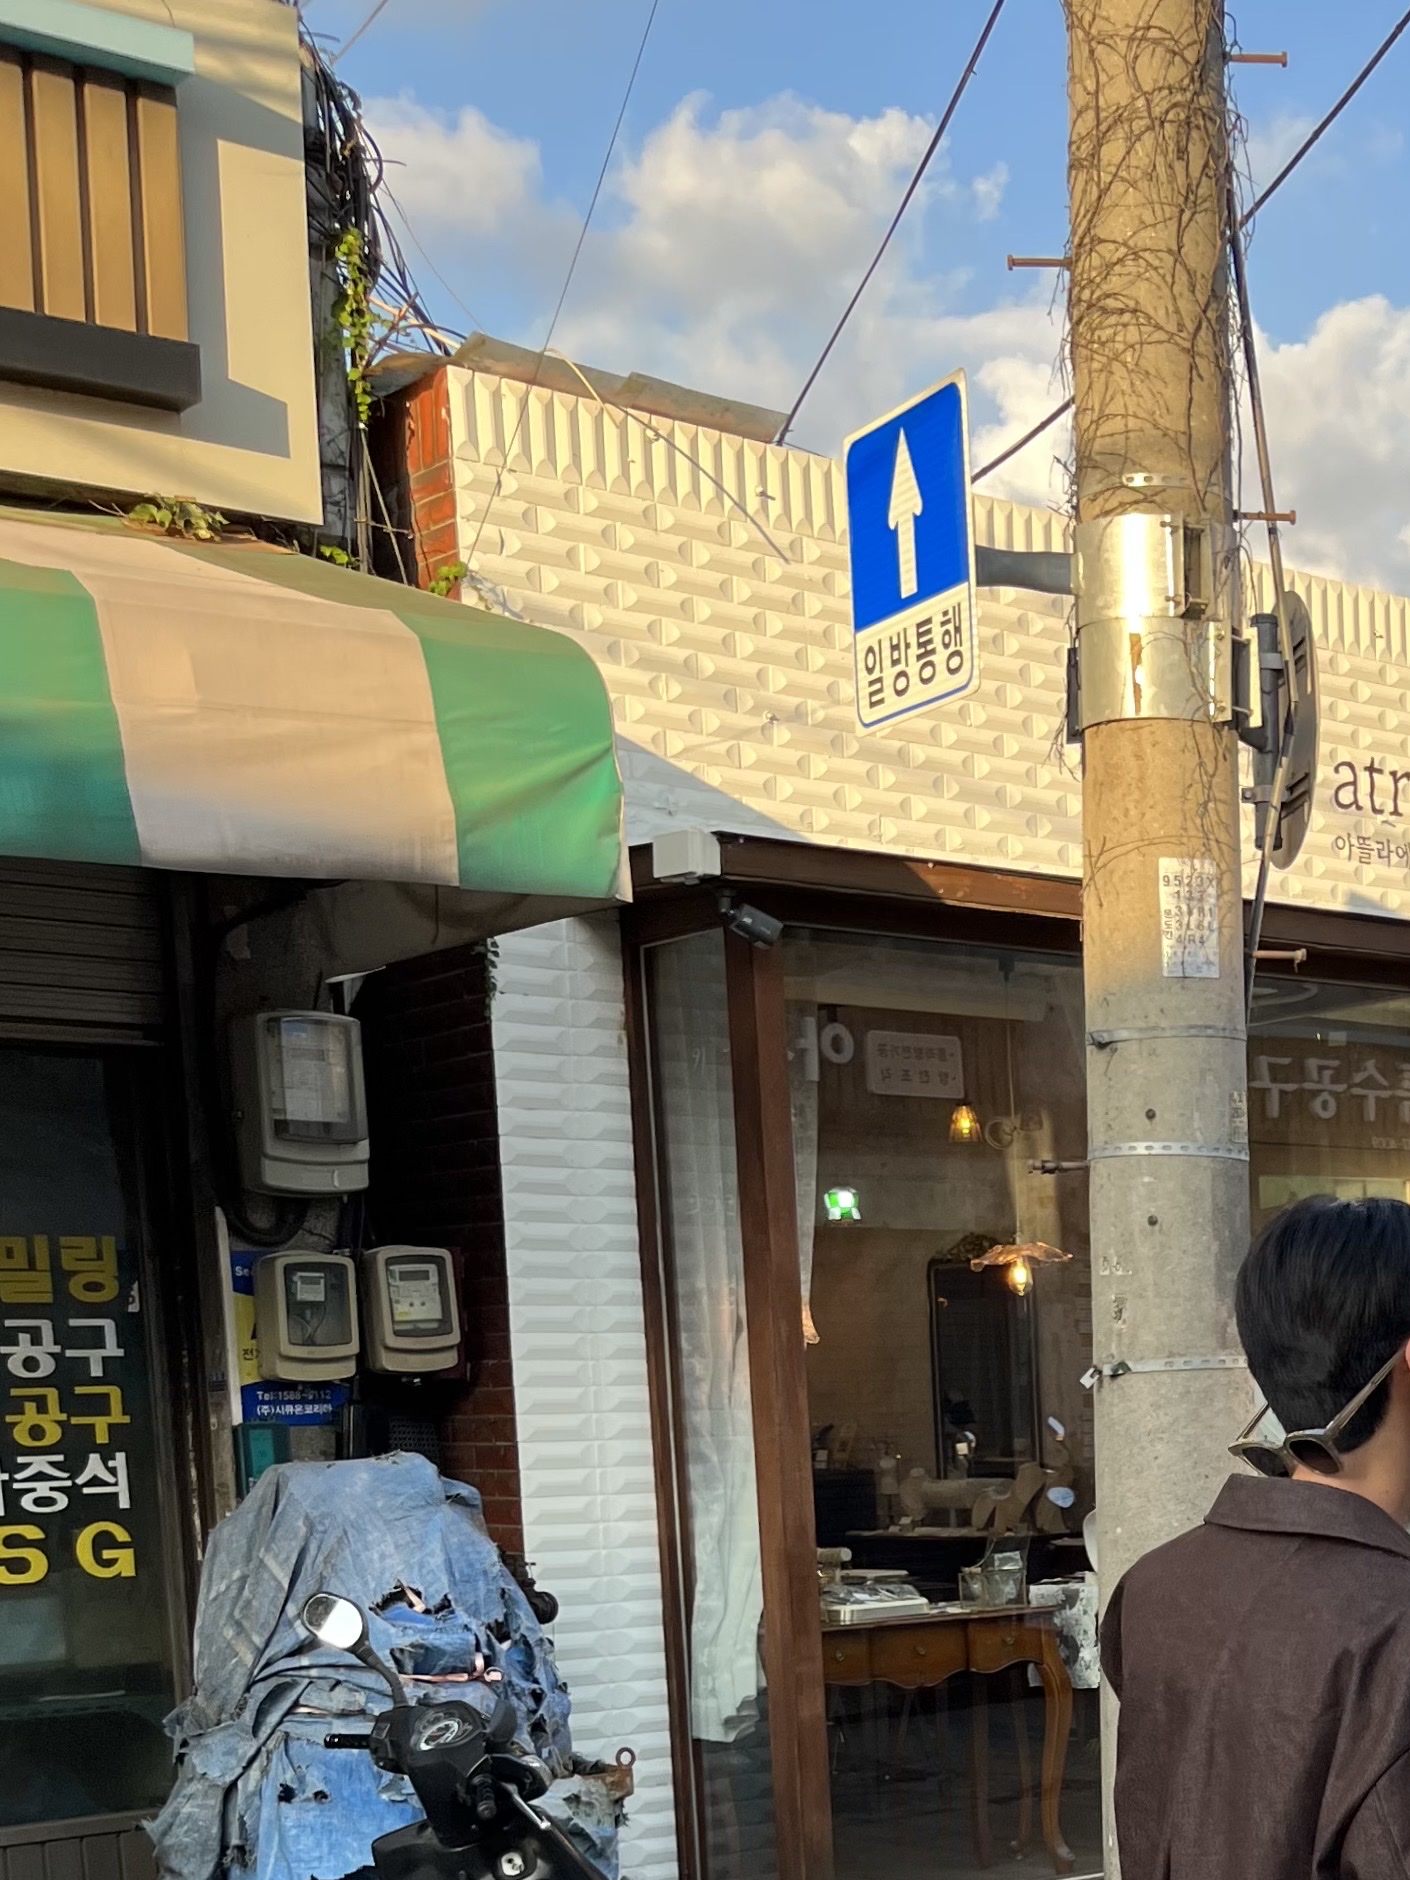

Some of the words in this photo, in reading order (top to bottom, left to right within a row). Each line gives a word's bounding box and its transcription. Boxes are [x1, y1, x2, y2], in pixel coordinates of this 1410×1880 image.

[864, 602, 964, 709] 일방통행
[0, 1234, 119, 1303] 밀링
[0, 1318, 124, 1379] 공구
[5, 1385, 131, 1447] 공구
